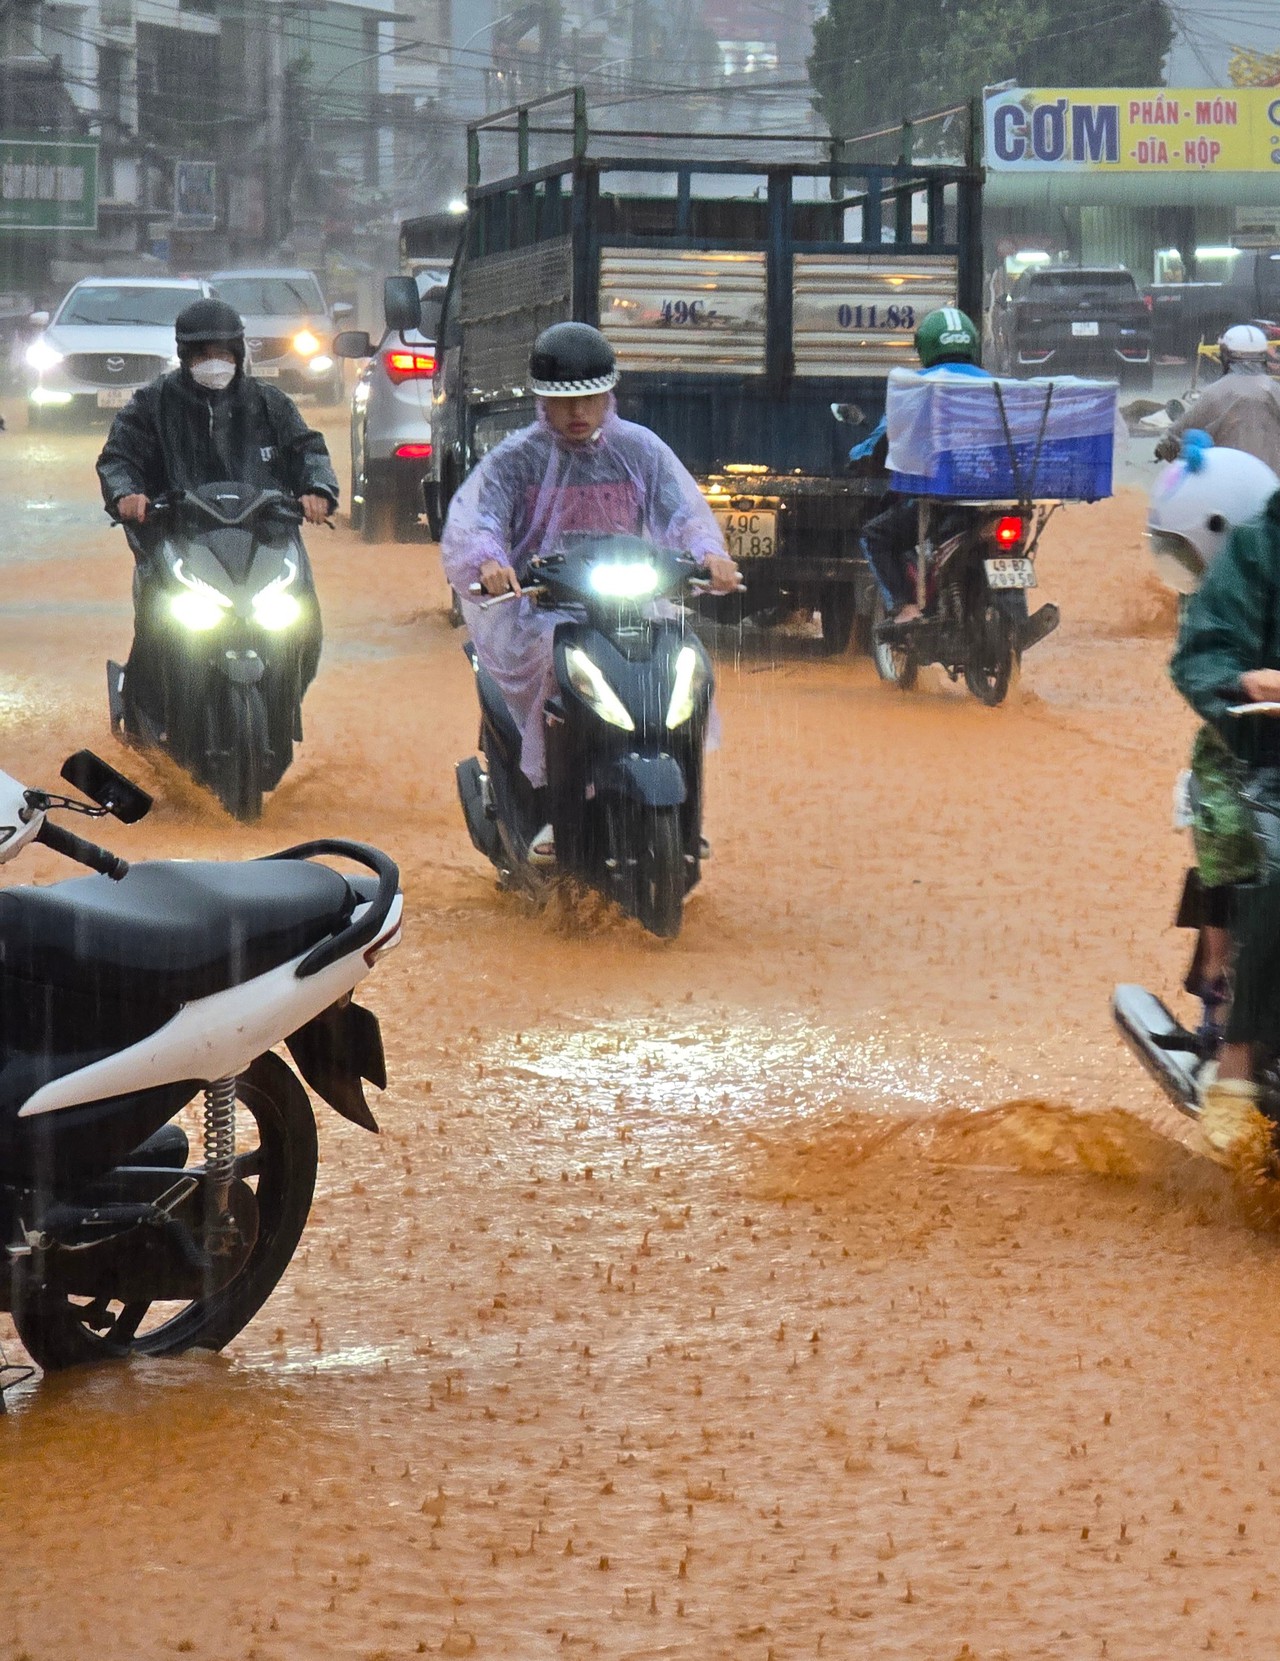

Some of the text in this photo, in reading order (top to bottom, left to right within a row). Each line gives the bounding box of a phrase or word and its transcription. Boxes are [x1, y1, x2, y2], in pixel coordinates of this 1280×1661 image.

[1195, 96, 1237, 124] MÓN
[993, 99, 1119, 162] CƠM
[1184, 136, 1220, 168] HỘP
[837, 303, 916, 330] 011.83
[939, 331, 971, 345] Grab
[726, 514, 760, 534] 49C
